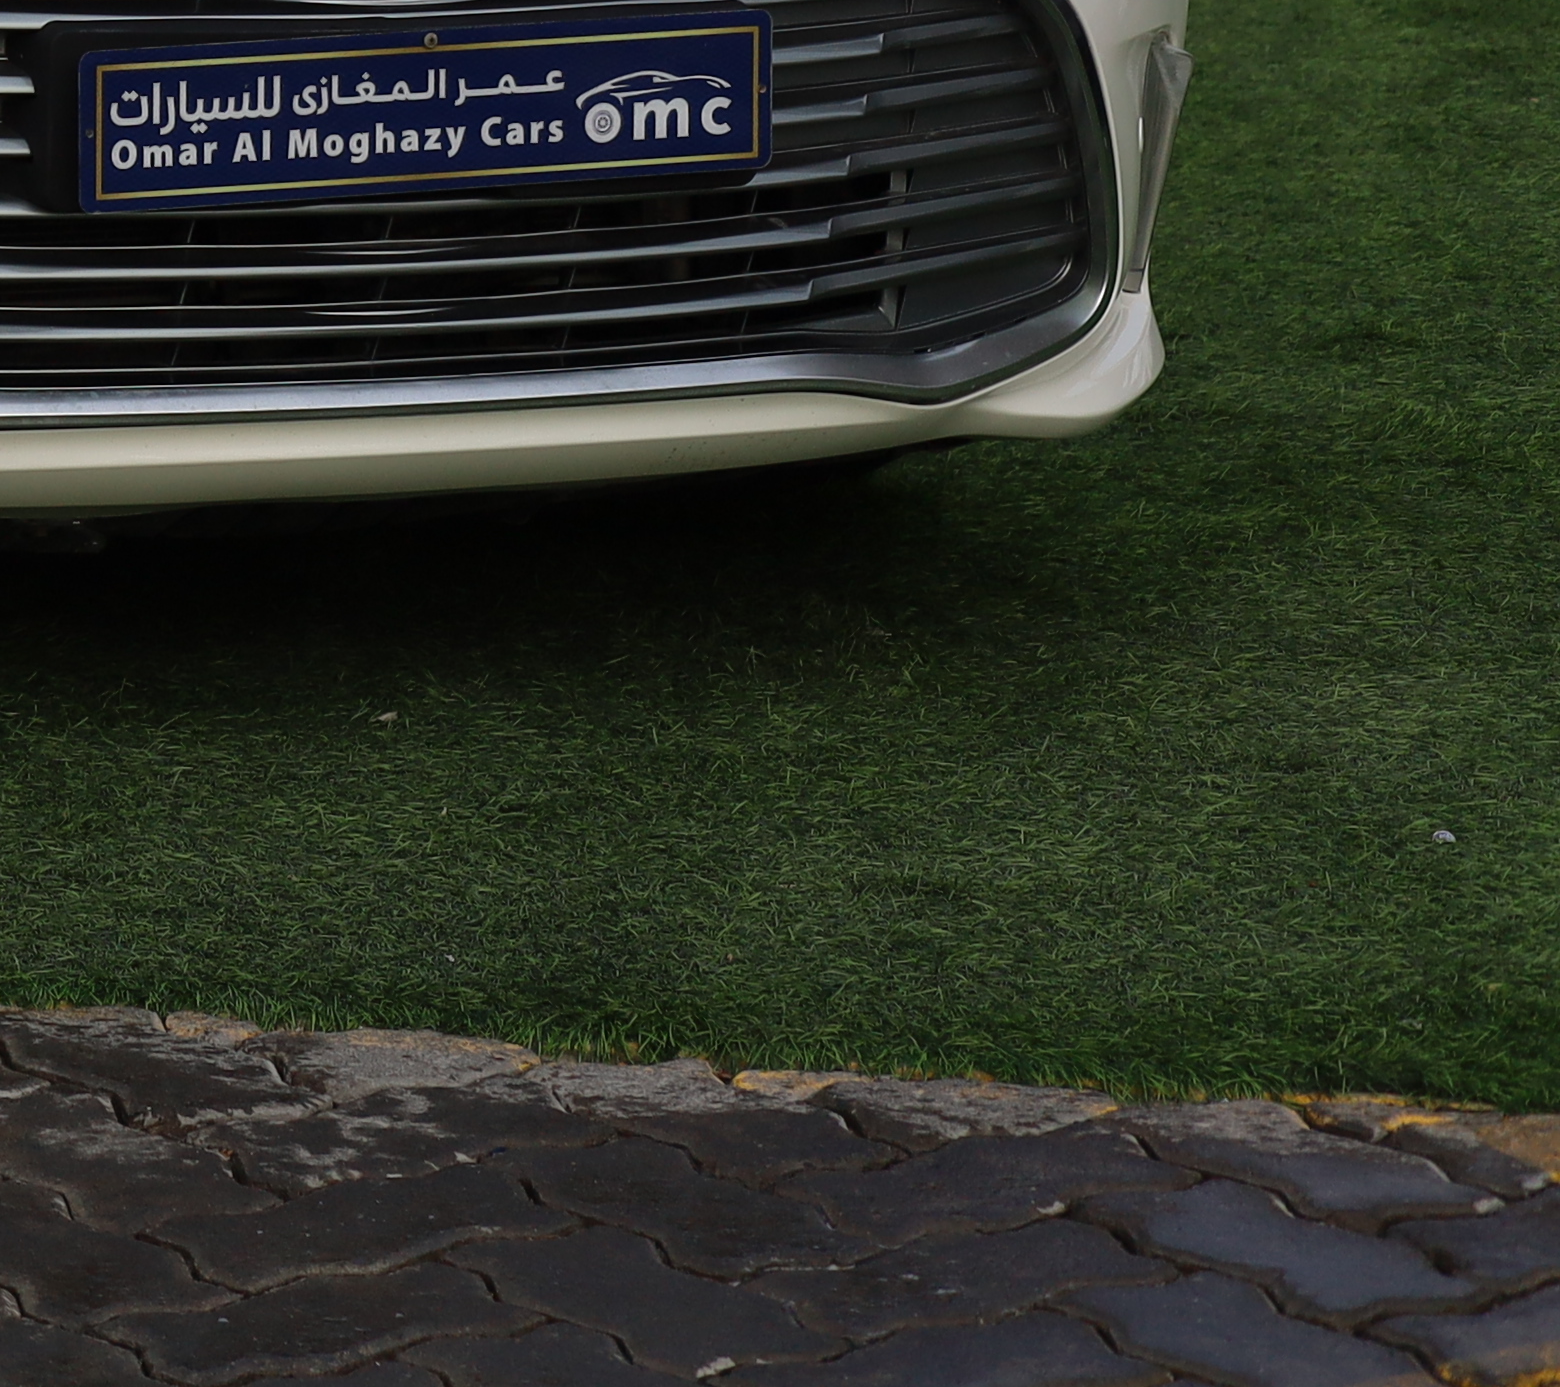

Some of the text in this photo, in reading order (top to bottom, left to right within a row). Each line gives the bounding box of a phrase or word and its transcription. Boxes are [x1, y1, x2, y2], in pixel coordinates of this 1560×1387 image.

[110, 68, 565, 135] عمر المغازى للسيارات
[584, 95, 732, 144] omc
[110, 116, 564, 170] Omar Al Moghazy Cars
